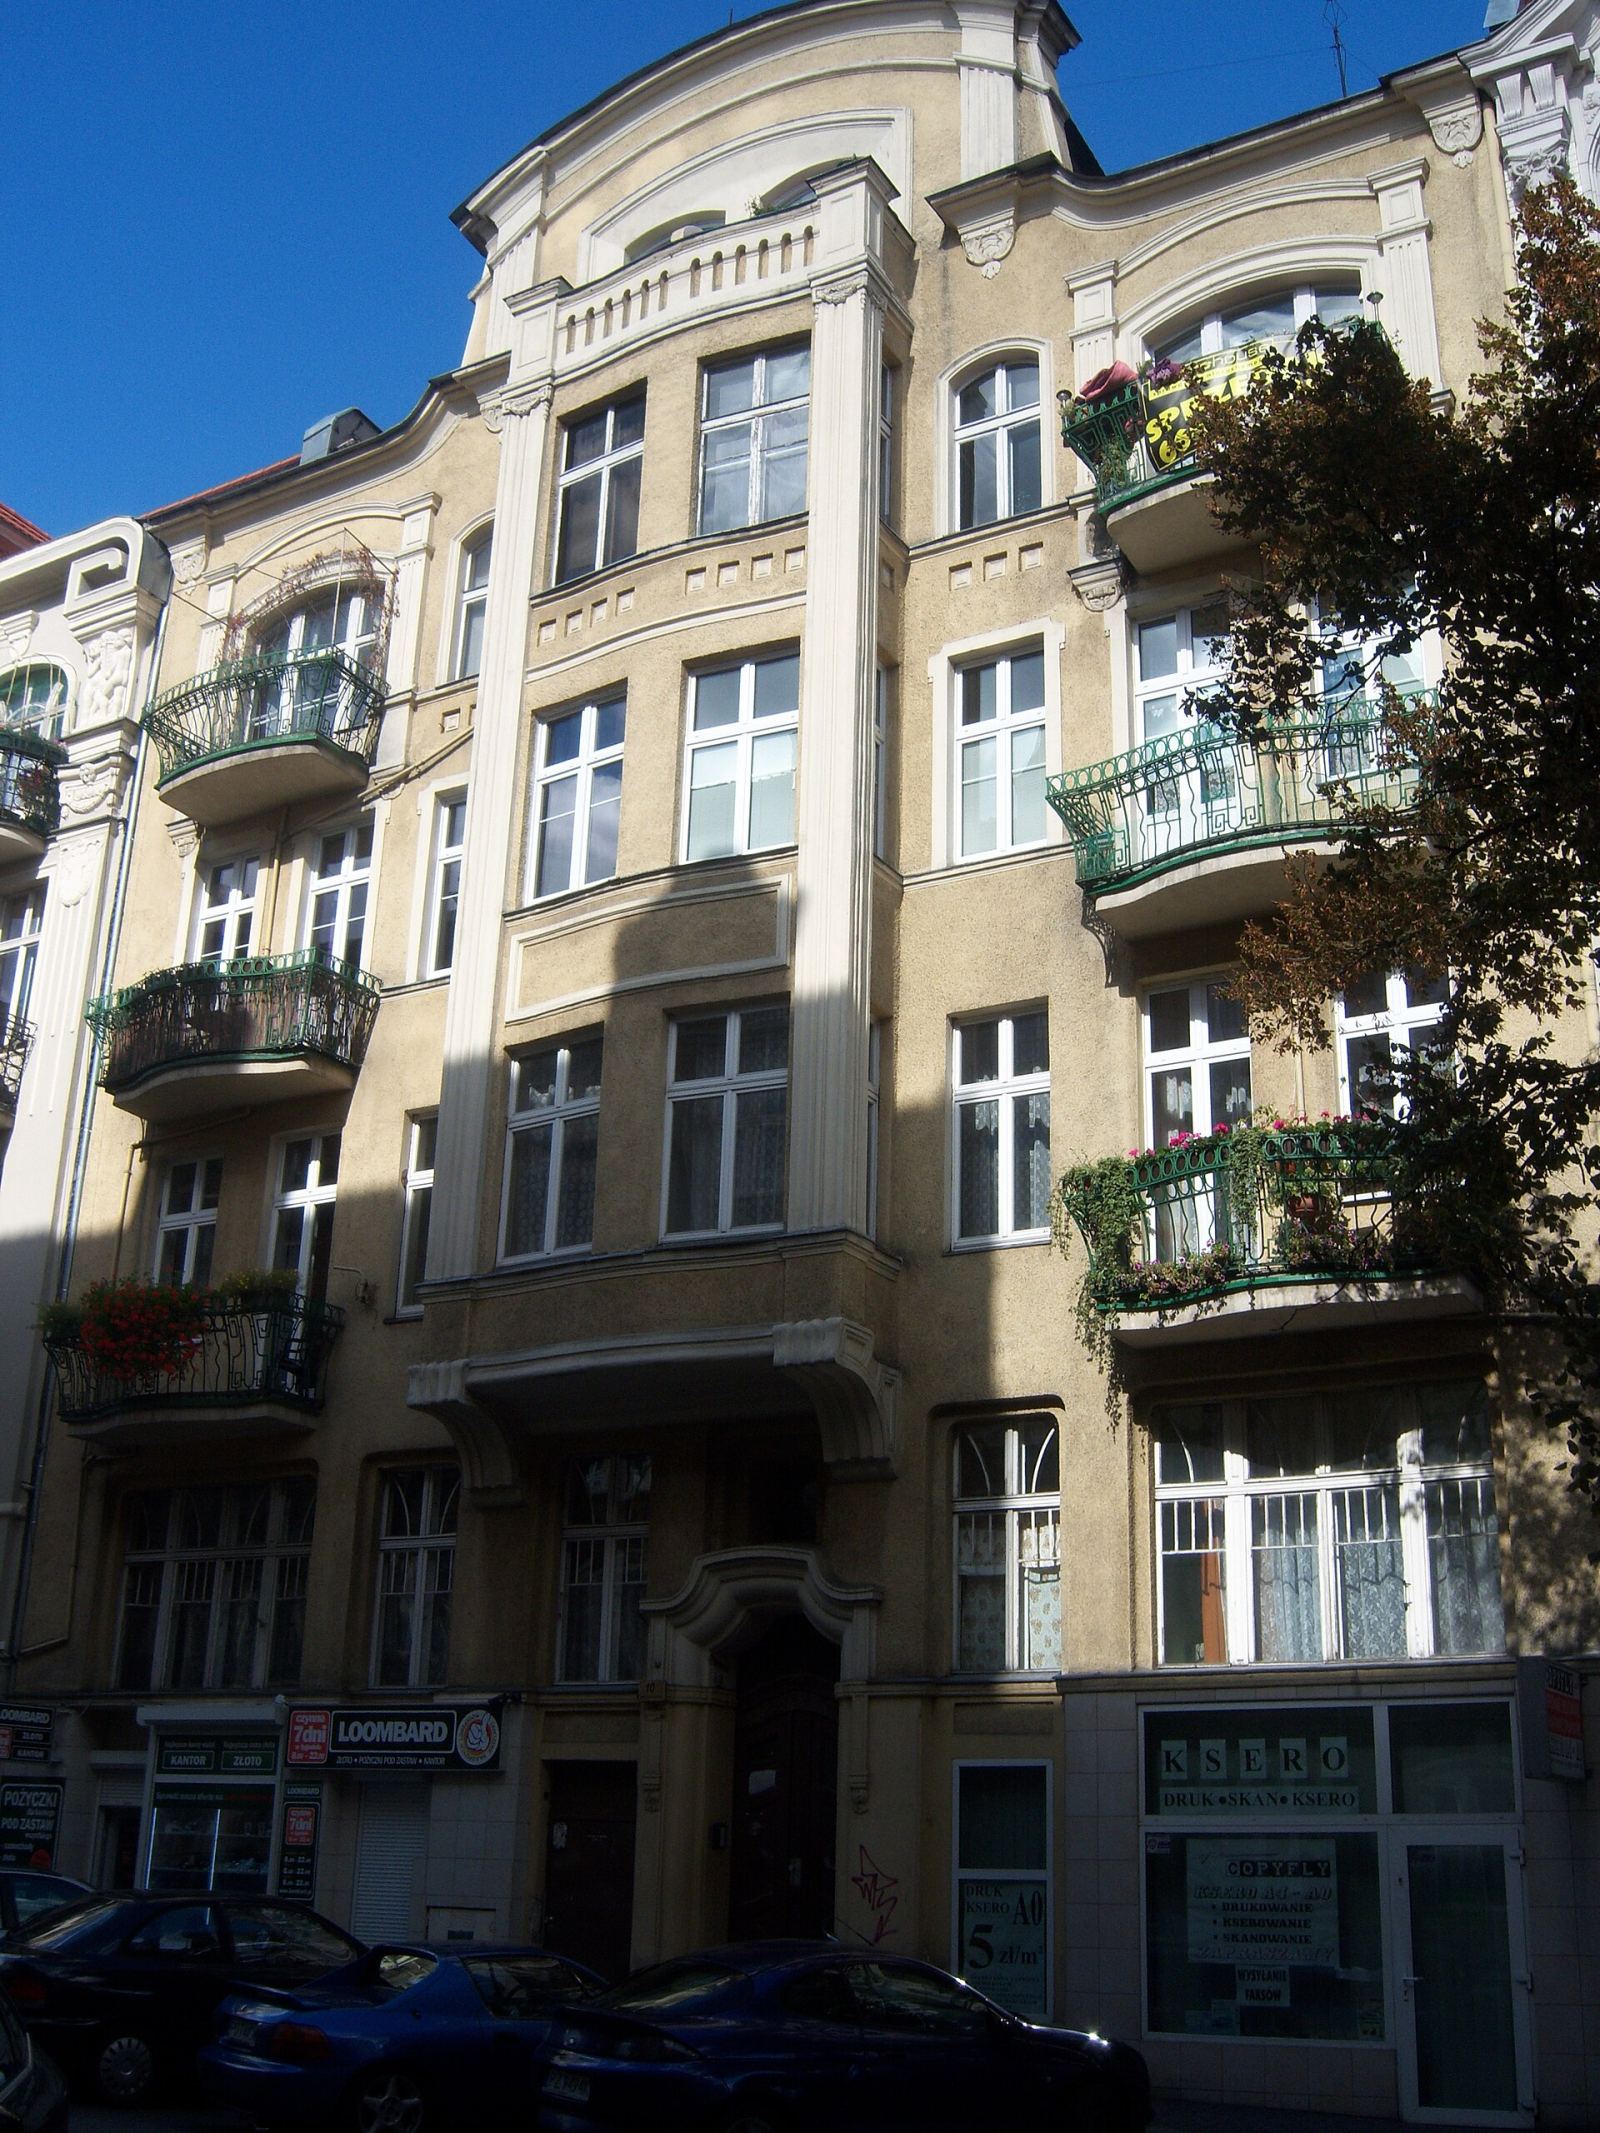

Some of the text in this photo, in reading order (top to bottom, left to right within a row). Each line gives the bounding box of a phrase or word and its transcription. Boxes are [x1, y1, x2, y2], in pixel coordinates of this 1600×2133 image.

[0, 1708, 50, 1724] OOMBARD
[337, 1721, 449, 1744] LOOMBARD
[169, 1755, 207, 1767] KANTOR
[232, 1755, 263, 1767] ZŁOTO
[1164, 1746, 1345, 1773] KSERO
[4, 1788, 57, 1808] POŻYCZKI
[1164, 1791, 1355, 1807] DRUK SKAN KSERO
[1227, 1860, 1331, 1878] COPYFLY
[965, 1885, 1003, 1897] DRUK
[965, 1902, 1010, 1913] KSERO
[1221, 1903, 1313, 1914] DRUKOWANIE
[1222, 1919, 1312, 1930] KSEROWANIE
[969, 1924, 994, 1969] 5
[1223, 1934, 1312, 1945] SKANOWANIE
[1237, 1967, 1287, 1982] WYSYŁANIE
[1245, 1987, 1281, 2001] FAKSÓW
